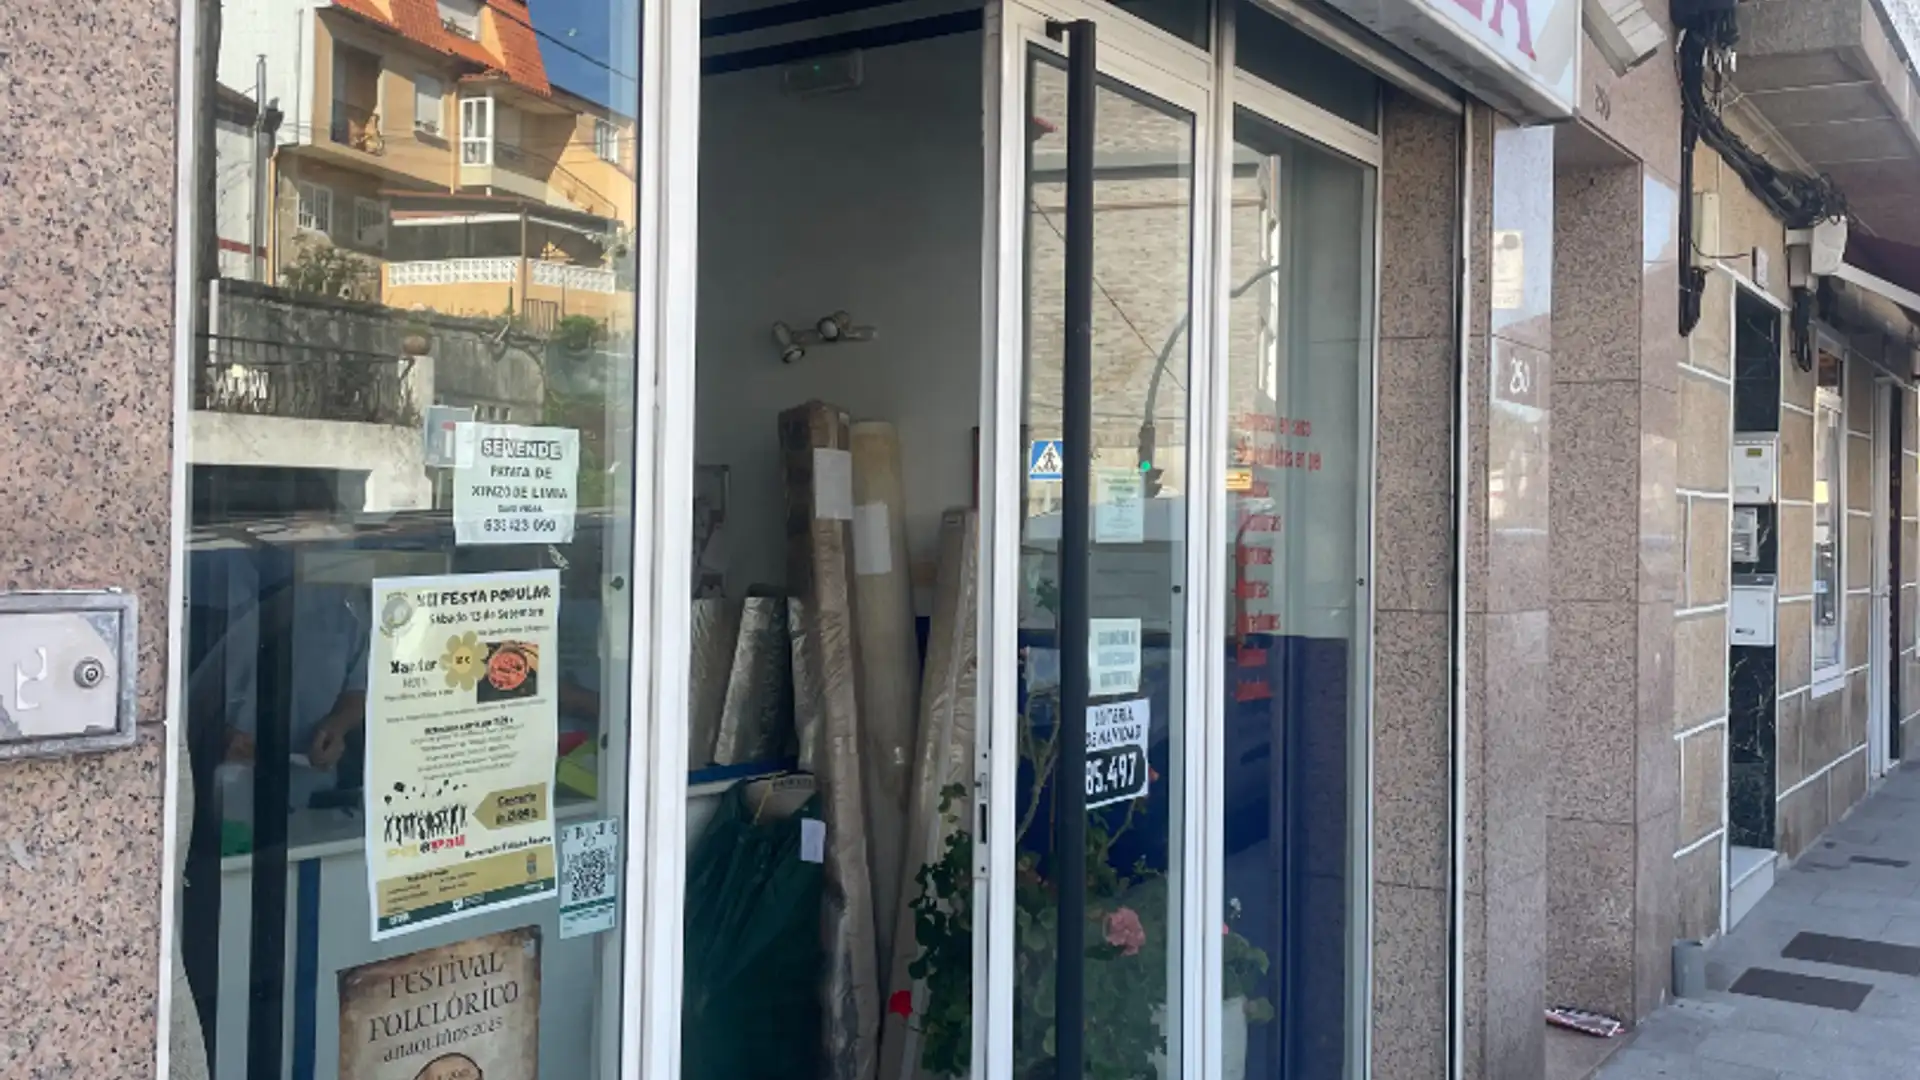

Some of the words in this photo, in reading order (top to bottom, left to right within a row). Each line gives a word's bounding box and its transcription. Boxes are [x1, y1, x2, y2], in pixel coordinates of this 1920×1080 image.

[503, 439, 562, 460] VENDE
[535, 467, 552, 479] DE
[512, 486, 528, 498] DE
[440, 589, 488, 607] FESTA
[490, 584, 551, 602] POPULAR
